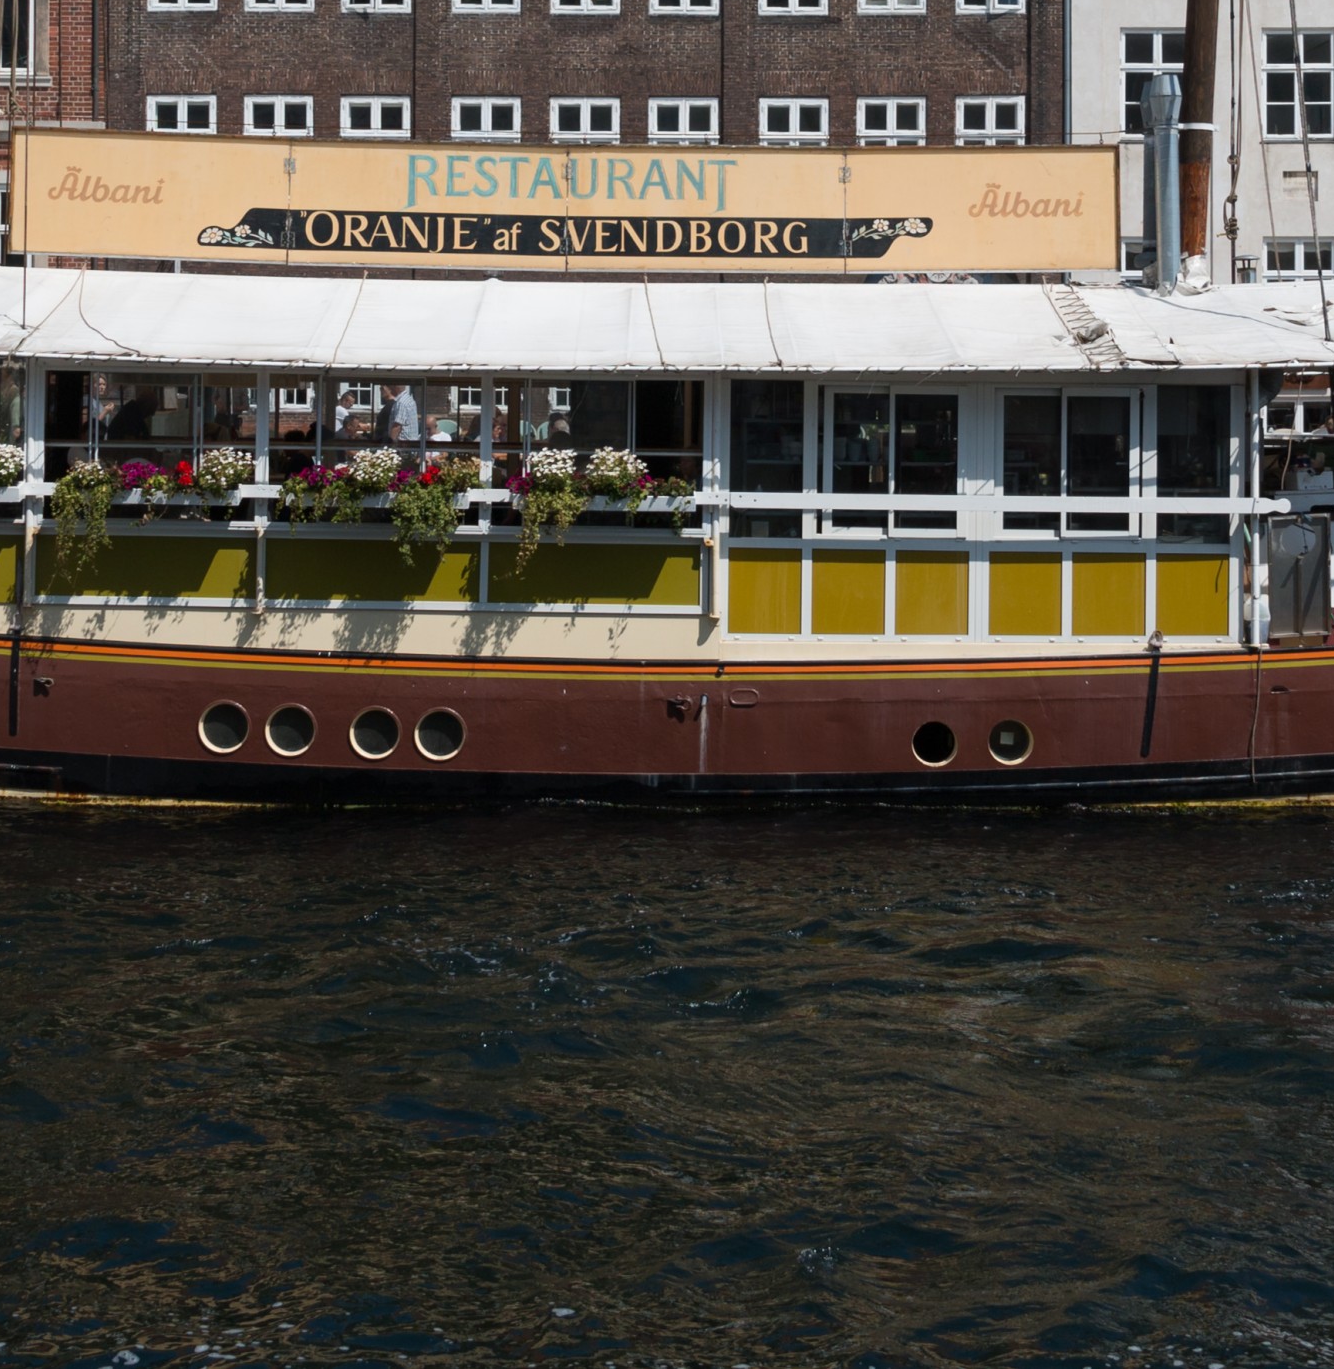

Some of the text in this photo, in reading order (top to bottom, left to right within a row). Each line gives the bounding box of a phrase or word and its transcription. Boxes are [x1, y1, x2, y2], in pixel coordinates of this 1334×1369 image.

[47, 170, 165, 204] Albani
[404, 154, 738, 213] RESTAURANT
[968, 187, 1085, 218] Albani
[493, 222, 522, 251] af
[538, 218, 808, 254] SVENDBORG
